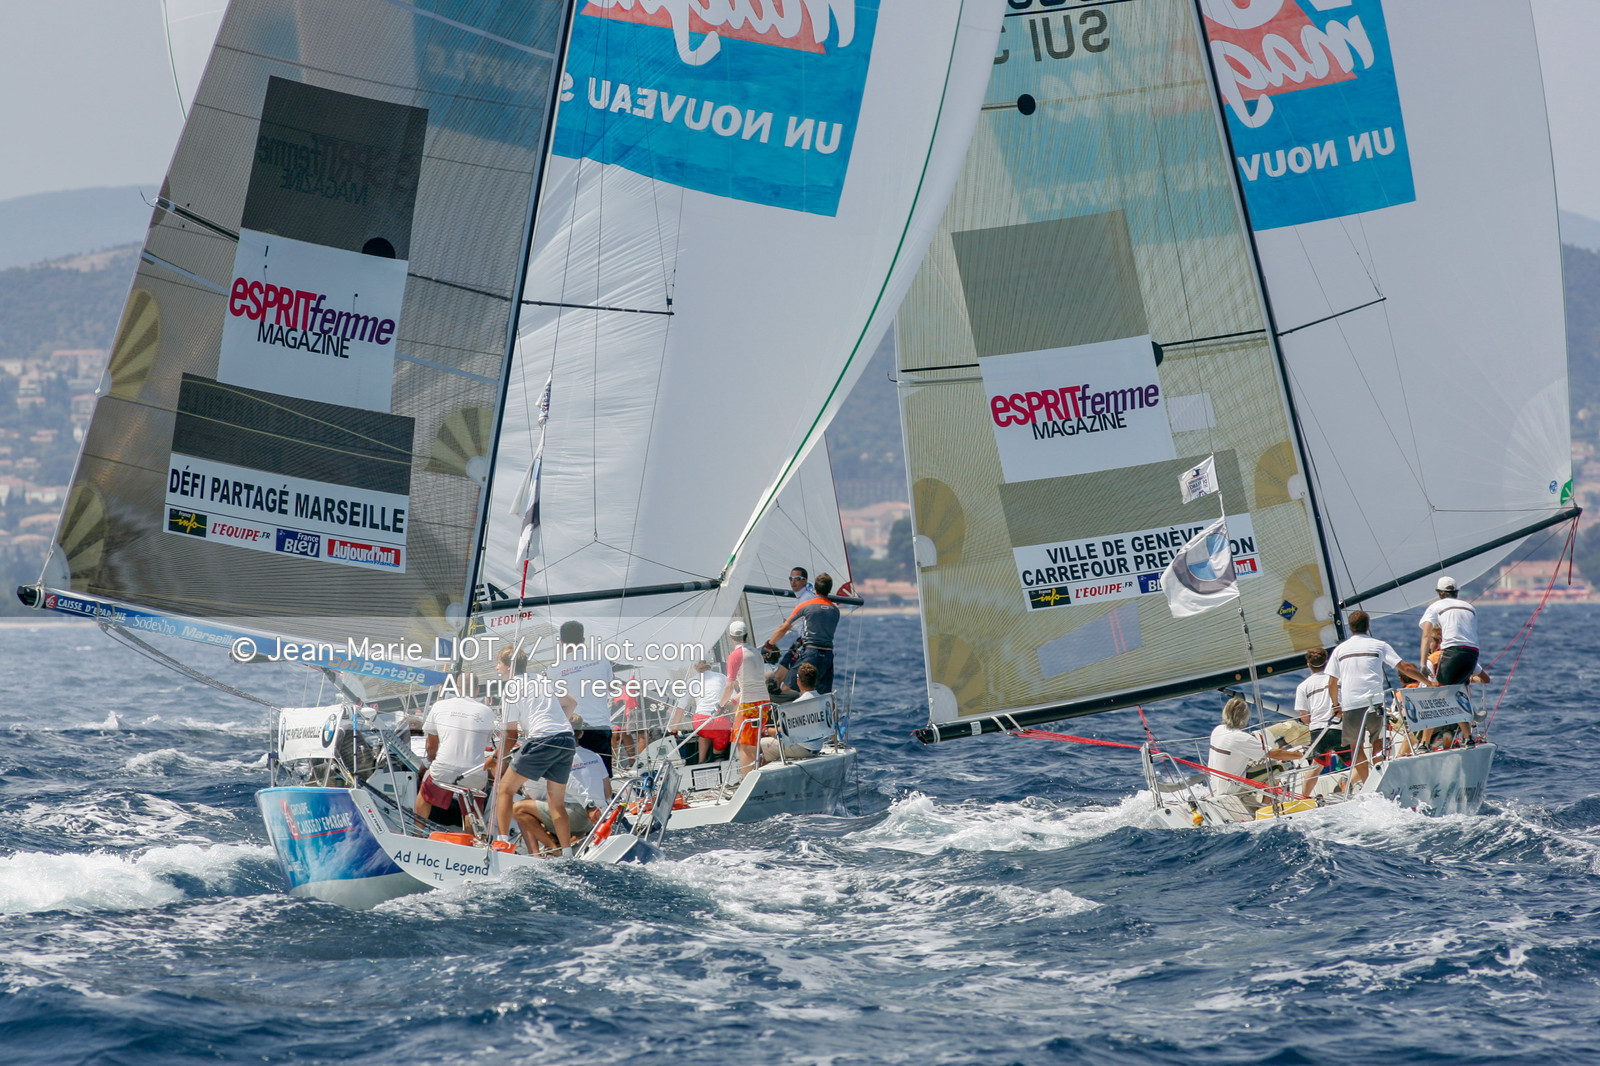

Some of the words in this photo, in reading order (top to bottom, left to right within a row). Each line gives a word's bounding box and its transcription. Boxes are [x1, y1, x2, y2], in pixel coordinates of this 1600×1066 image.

[257, 321, 350, 359] MAGAZINE
[1032, 412, 1127, 440] MAGAZINE
[169, 465, 205, 499] DÉFI
[210, 477, 289, 515] PARTAGÉ
[295, 493, 405, 533] MARSEILLE
[297, 532, 319, 543] France
[333, 541, 396, 564] Aujourd'hui
[1047, 543, 1096, 564] VILLE
[1102, 539, 1125, 556] DE
[1022, 559, 1130, 586] CARREFOUR
[57, 598, 82, 611] CAISSE
[394, 850, 411, 863] Ad
[416, 853, 440, 868] Hoc
[445, 857, 490, 877] Legend
[433, 872, 445, 882] TL
